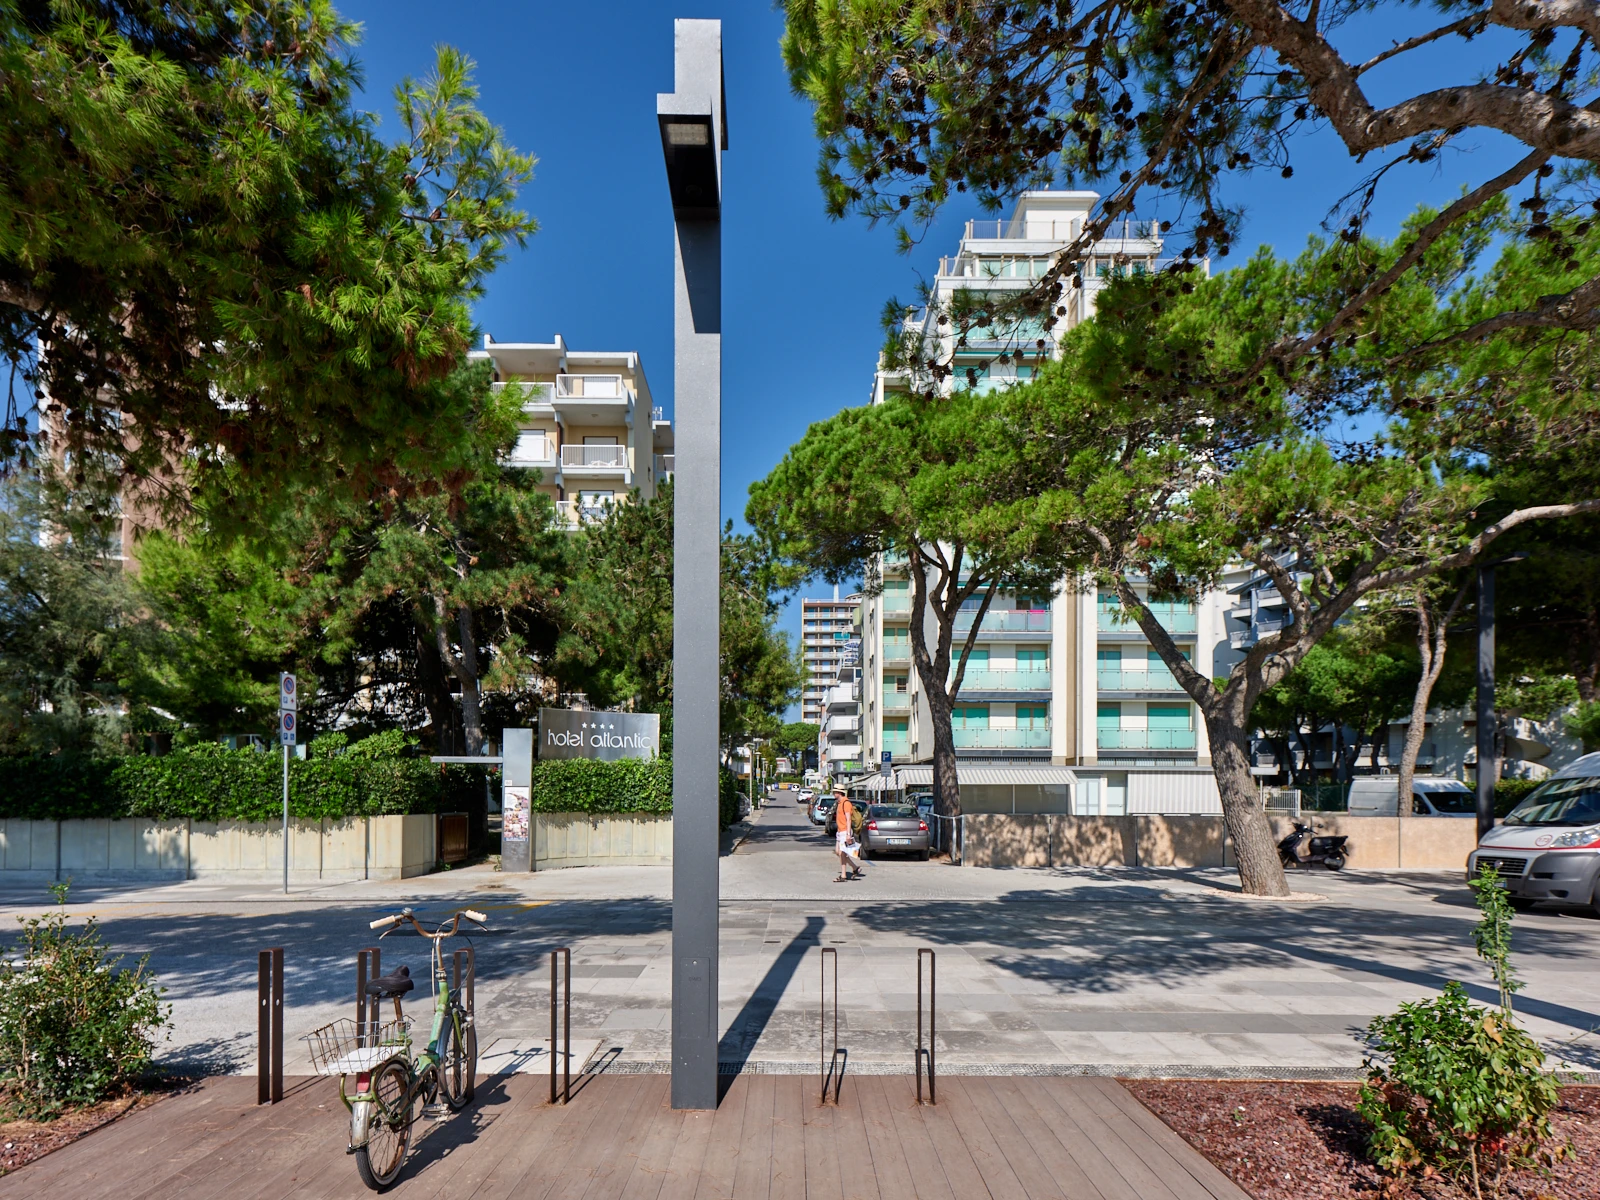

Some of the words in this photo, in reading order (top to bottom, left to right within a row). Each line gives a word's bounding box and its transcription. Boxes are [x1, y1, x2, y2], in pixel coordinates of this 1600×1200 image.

[547, 728, 584, 747] hotel
[590, 731, 651, 749] atlantic
[883, 752, 890, 761] P
